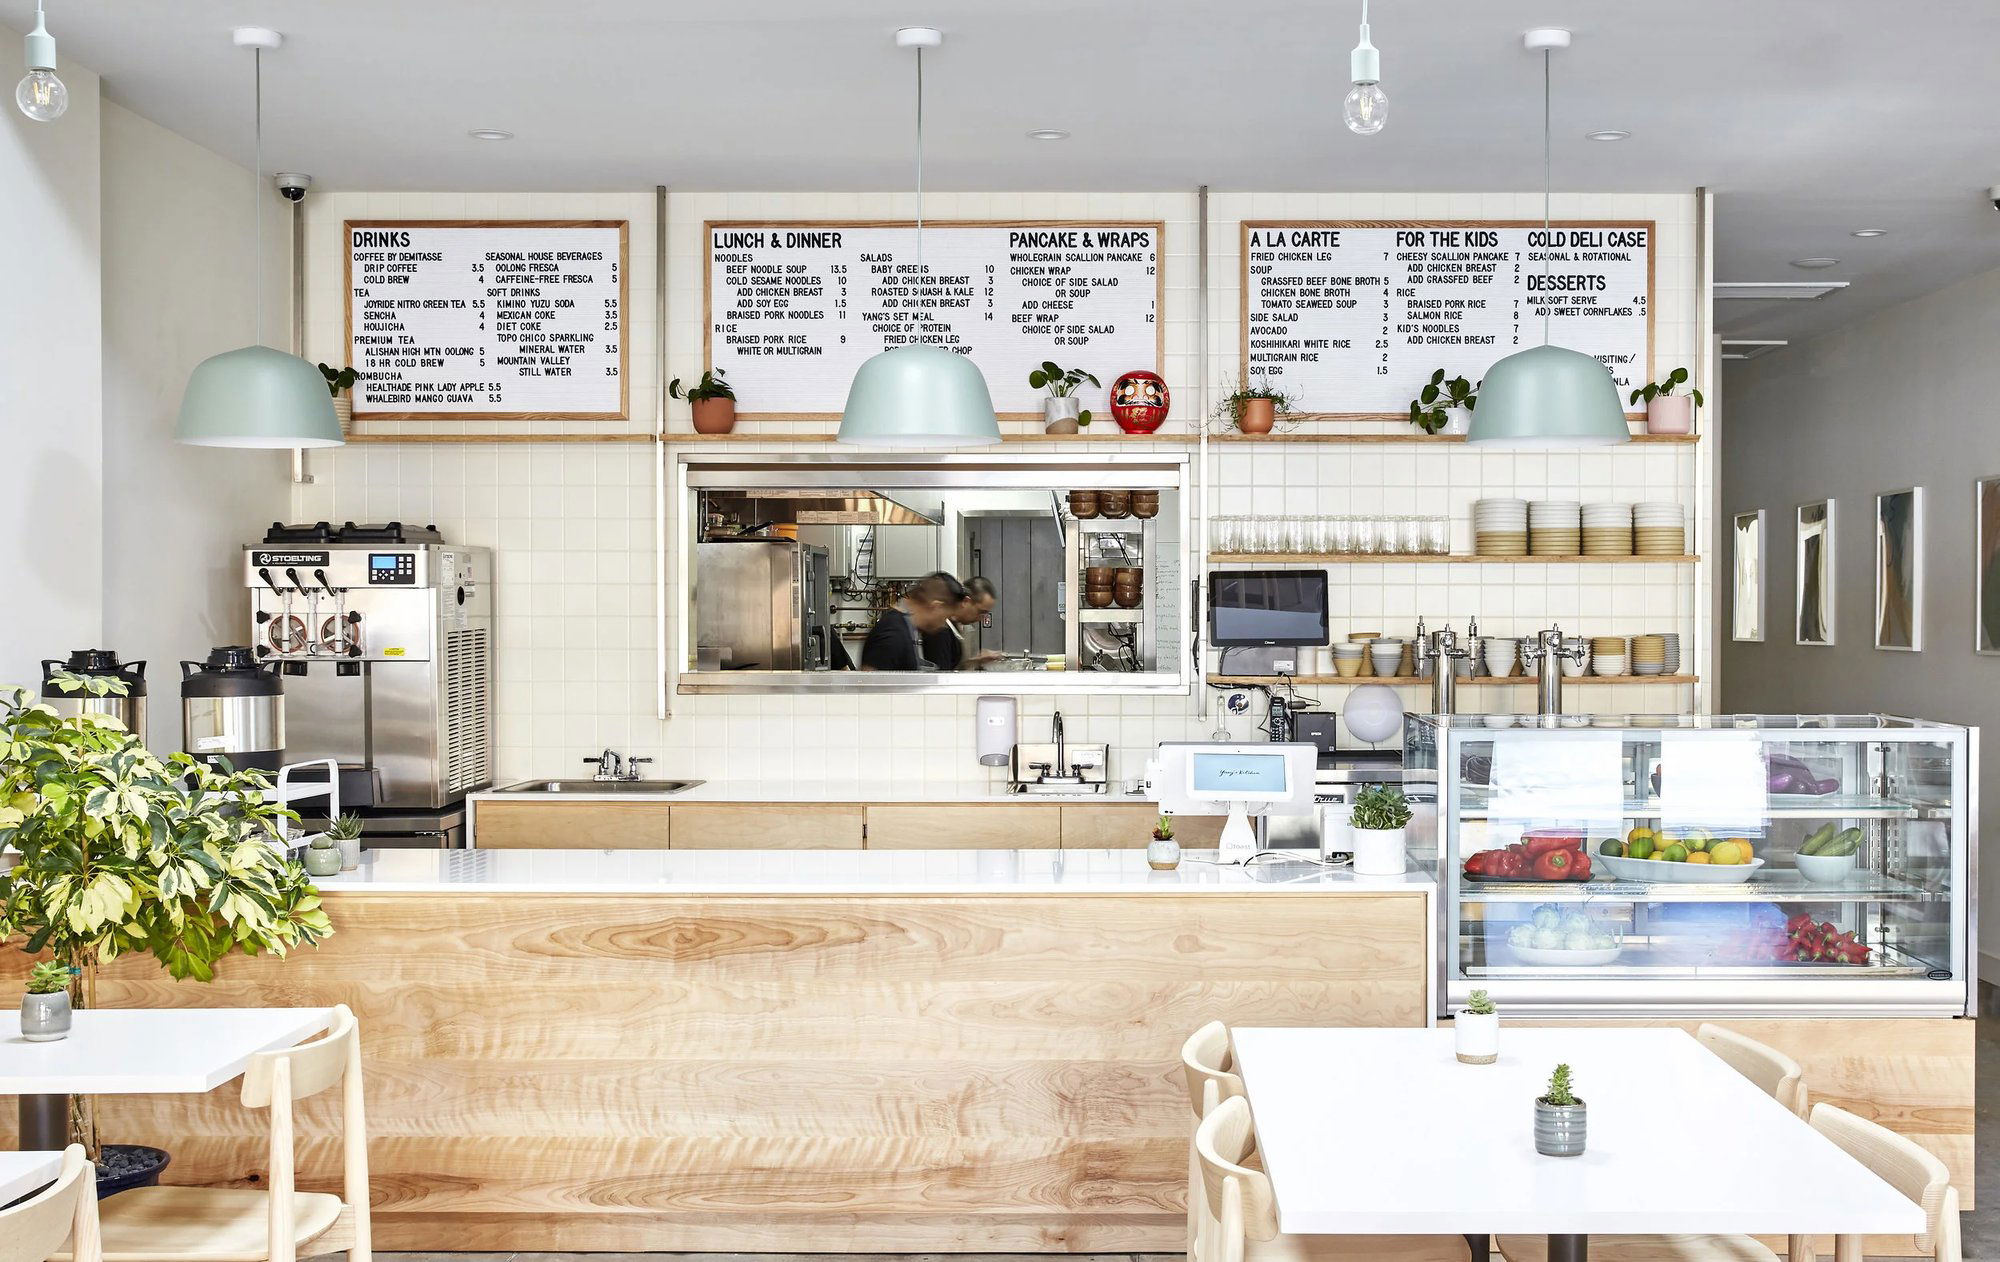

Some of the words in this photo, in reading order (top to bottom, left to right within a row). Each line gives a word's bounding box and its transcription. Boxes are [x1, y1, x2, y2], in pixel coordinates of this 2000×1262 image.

[353, 232, 410, 247] DRINKS
[714, 232, 764, 248] LUNCH
[771, 232, 782, 248] &
[786, 232, 842, 248] DINNER
[1010, 232, 1077, 248] PANCAKE
[1082, 232, 1094, 248] &
[1098, 232, 1149, 248] WRAPS
[1250, 231, 1261, 247] A
[1267, 231, 1286, 247] LA
[1291, 231, 1340, 247] CARTE
[1396, 231, 1425, 247] FOR
[1430, 231, 1460, 247] THE
[1465, 231, 1499, 247] KIDS
[1527, 232, 1566, 247] COLD
[1571, 232, 1602, 247] DELI
[1608, 232, 1646, 247] CASE
[354, 253, 384, 261] COFFEE
[387, 253, 397, 261] BY
[400, 253, 442, 261] DEMITASSE
[485, 252, 525, 261] SEASONAL
[528, 252, 553, 261] HOUSE
[557, 252, 602, 261] BEVERAGES
[714, 254, 753, 262] NOODLES
[860, 254, 892, 262] SALADS
[1010, 253, 1062, 261] WHOLEGRAIN
[1065, 253, 1104, 261] SCALLION
[1107, 253, 1143, 261] PANCAKE
[1251, 253, 1275, 261] FRIED
[1278, 253, 1313, 261] CHICKEN
[1316, 253, 1332, 261] LEG
[1396, 253, 1428, 261] CHEESY
[1431, 253, 1470, 261] SCALLION
[1473, 253, 1509, 261] PANCAKE
[1573, 253, 1579, 261] &
[1583, 253, 1631, 261] ROTATIONAL
[364, 264, 384, 272] DRIP
[387, 264, 417, 272] COFFEE
[472, 264, 484, 272] 3.5
[726, 265, 747, 273] BEEF
[751, 265, 782, 273] NOODLE
[786, 265, 807, 273] SOUP
[831, 265, 847, 273] 13.5
[1010, 267, 1045, 275] CHICKEN
[1048, 267, 1071, 275] WRAP
[1146, 267, 1155, 275] 12
[1250, 266, 1273, 274] SOUP
[495, 275, 560, 283] CAFFEINE-FREE
[563, 275, 593, 283] FRESCA
[726, 277, 747, 285] COLD
[751, 277, 782, 285] SESAME
[785, 277, 821, 285] NOODLES
[838, 277, 847, 285] 10
[1022, 278, 1052, 286] CHOICE
[1055, 278, 1066, 286] OF
[1069, 278, 1088, 286] SIDE
[1091, 278, 1118, 286] SALAD
[1261, 277, 1303, 285] GRASSFED
[1306, 277, 1327, 285] BEEF
[1330, 277, 1351, 285] BONE
[1355, 277, 1380, 285] BROTH
[1407, 275, 1423, 284] ADD
[1427, 275, 1469, 284] GRASSFED
[1472, 275, 1493, 284] BEEF
[1527, 275, 1606, 291] DESSERTS
[354, 289, 370, 297] TEA
[487, 288, 507, 297] SOFT
[511, 288, 540, 297] DRINKS
[1055, 289, 1066, 298] OR
[1069, 289, 1090, 298] SOUP
[1396, 289, 1416, 297] RICE
[364, 300, 395, 309] JOYRIDE
[397, 300, 420, 309] NITRO
[423, 300, 448, 309] GREEN
[450, 300, 466, 309] TEA
[472, 300, 485, 309] 5.5
[497, 300, 526, 308] KIMINO
[530, 300, 550, 308] YUZU
[555, 300, 575, 308] SODA
[604, 300, 617, 308] 5.5
[737, 299, 753, 308] ADD
[756, 299, 771, 308] SOY
[774, 299, 789, 308] EGG
[835, 299, 847, 308] 1.5
[1261, 300, 1292, 308] TOMATO
[1295, 300, 1333, 308] SEAWEED
[1336, 300, 1357, 308] SOUP
[1527, 296, 1545, 305] MILK
[1548, 296, 1568, 305] SOFT
[1571, 296, 1597, 305] SERVE
[1633, 296, 1646, 305] 4.5
[1022, 301, 1038, 309] ADD
[1042, 301, 1073, 309] CHEESE
[364, 312, 396, 320] SENCHA
[496, 311, 531, 319] MEXICAN
[535, 311, 556, 319] COKE
[605, 311, 618, 319] 3.5
[727, 311, 760, 319] BRAISED
[764, 311, 785, 319] PORK
[788, 311, 824, 319] NOODLES
[862, 313, 890, 321] YANG'S
[893, 313, 909, 321] SET
[912, 313, 934, 321] MEAL
[984, 313, 993, 321] 14
[1012, 314, 1033, 322] BEEF
[1036, 314, 1059, 322] WRAP
[1145, 314, 1155, 322] 12
[1407, 311, 1441, 320] SALMON
[1444, 311, 1463, 320] RICE
[364, 323, 405, 331] HOUJICHA
[496, 322, 517, 331] DIET
[520, 322, 541, 331] COKE
[605, 322, 618, 331] 2.5
[715, 324, 737, 332] RICE
[1250, 326, 1287, 335] AVOCADO
[1397, 324, 1419, 333] KID'S
[1422, 324, 1460, 333] NOODLES
[354, 336, 392, 344] PREMIUM
[398, 336, 415, 344] TEA
[497, 334, 517, 342] TOPO
[519, 334, 546, 342] CHICO
[550, 334, 594, 342] SPARKLING
[1250, 340, 1300, 348] KOSHIHIKARI
[1304, 340, 1329, 348] WHITE
[1333, 340, 1351, 348] RICE
[1375, 340, 1388, 348] 2.5
[365, 348, 400, 356] ALISHAN
[402, 348, 421, 356] HIGH
[424, 348, 441, 356] MTN
[445, 348, 474, 356] OOLONG
[519, 345, 556, 353] MINERAL
[558, 345, 585, 353] WATER
[605, 345, 618, 353] 3.5
[366, 383, 412, 392] HEALTHADE
[415, 383, 434, 392] PINK
[437, 383, 457, 392] LADY
[460, 383, 484, 392] APPLE
[488, 383, 501, 392] 5.5
[366, 394, 411, 403] WHALEBIRD
[415, 394, 443, 403] MANGO
[446, 394, 473, 403] GUAVA
[489, 394, 501, 403] 5.5
